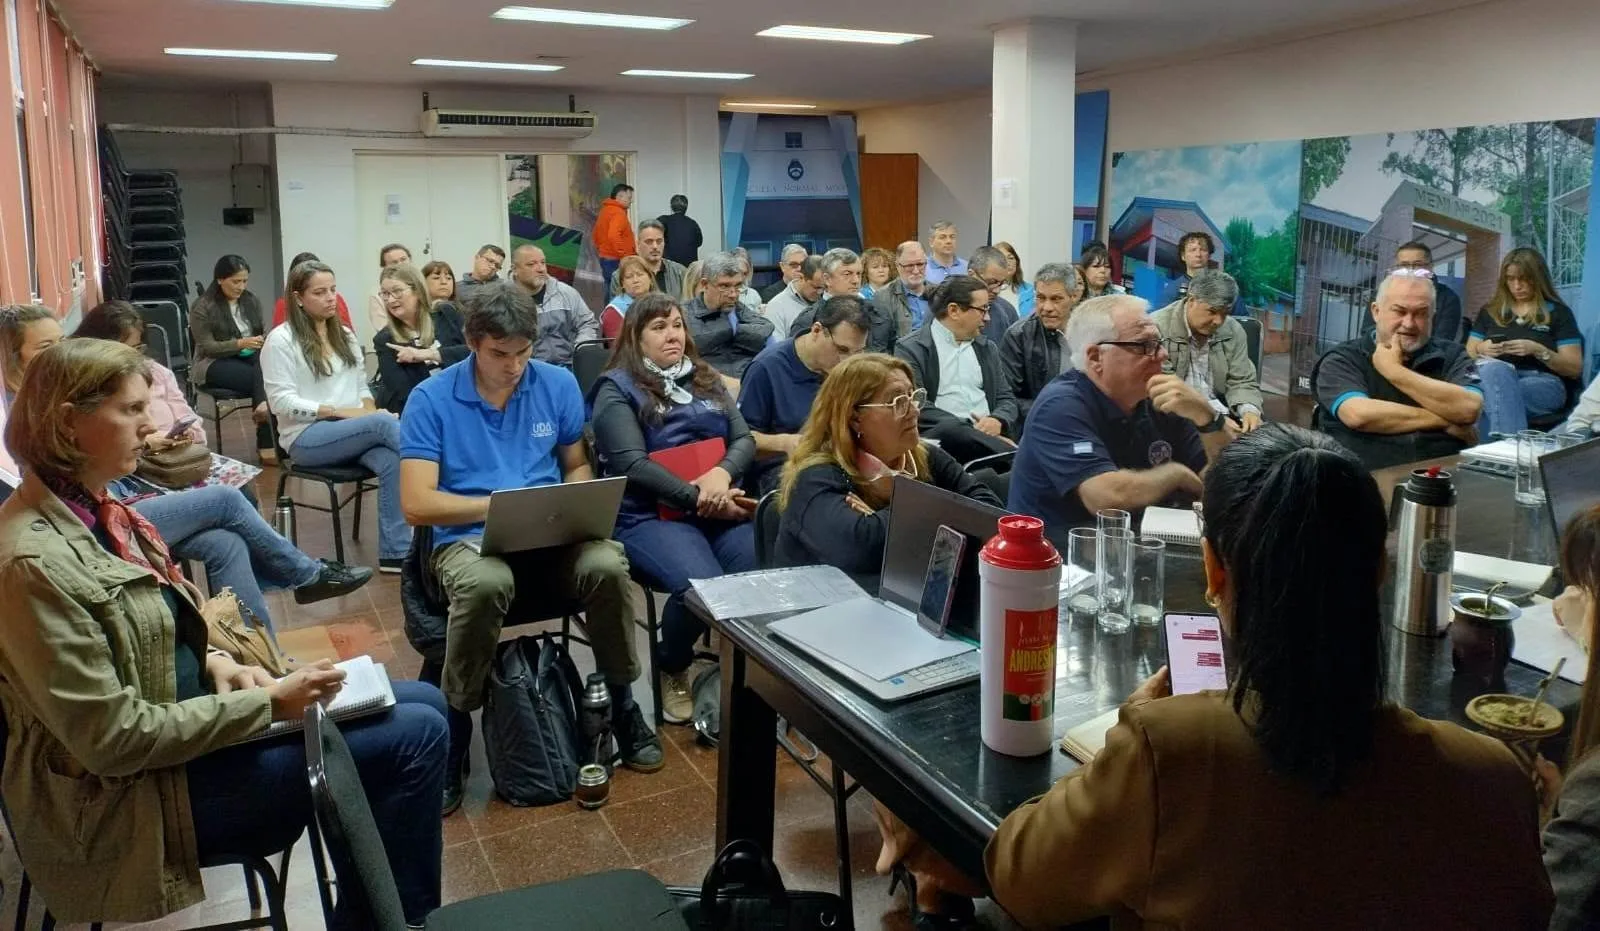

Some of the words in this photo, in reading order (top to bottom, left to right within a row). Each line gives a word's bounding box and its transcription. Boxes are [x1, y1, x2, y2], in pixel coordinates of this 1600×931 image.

[784, 183, 820, 193] NORMAL
[1472, 207, 1504, 230] 2021
[532, 421, 553, 433] UDA
